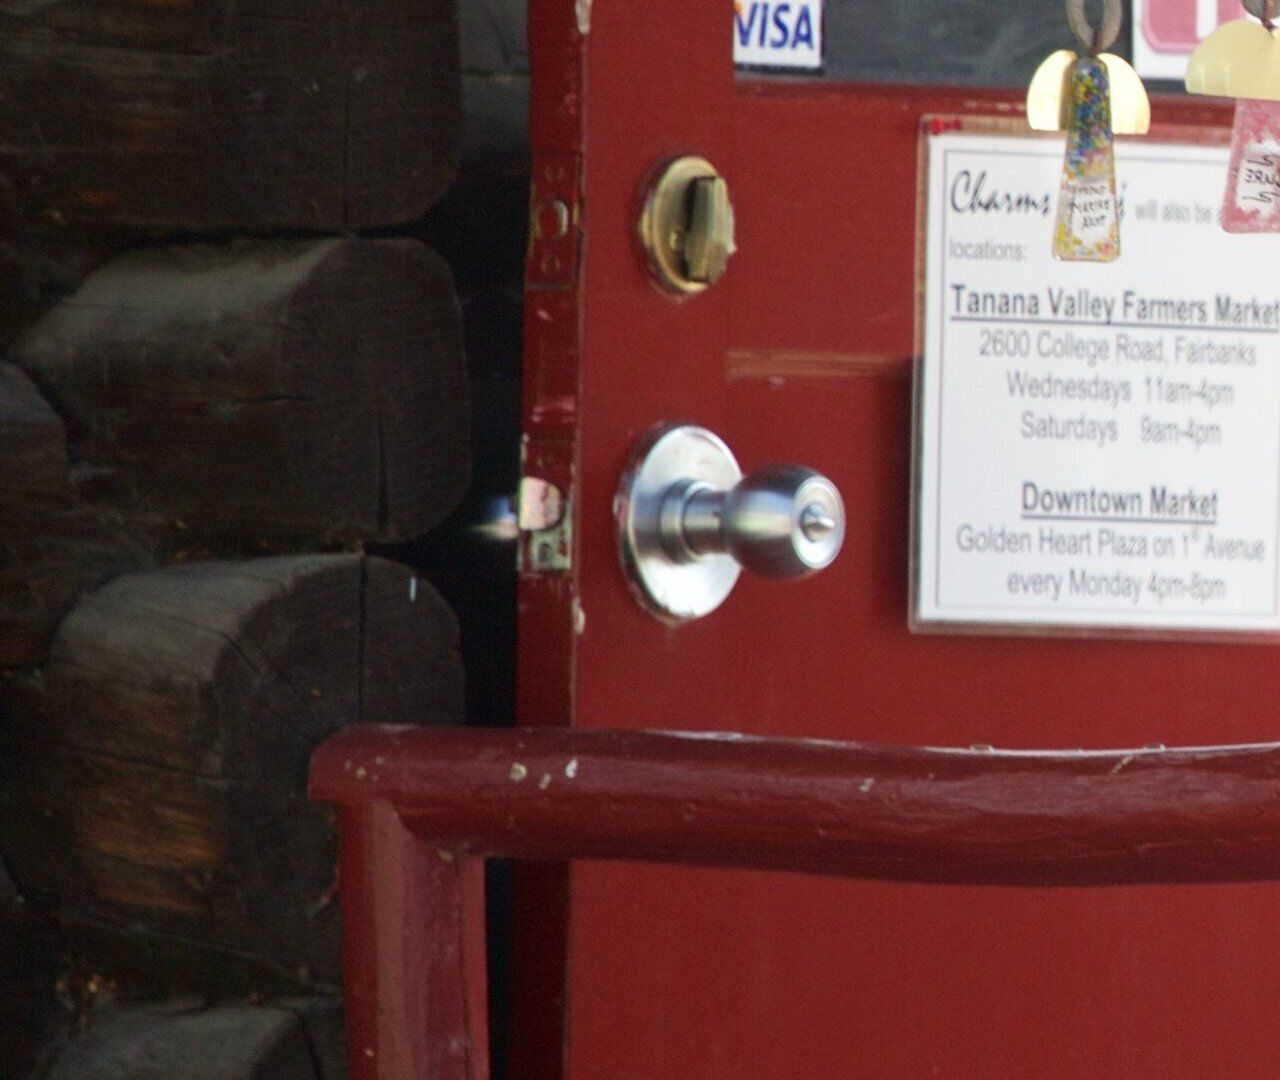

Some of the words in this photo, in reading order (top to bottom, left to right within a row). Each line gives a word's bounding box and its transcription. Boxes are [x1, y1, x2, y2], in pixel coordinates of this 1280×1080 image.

[736, 1, 814, 50] VISA
[950, 170, 1051, 216] Charms
[1135, 199, 1158, 220] will
[1162, 201, 1190, 222] also
[1194, 201, 1212, 223] be
[949, 238, 1027, 262] locations:
[951, 284, 1039, 314] Tanana
[1047, 287, 1115, 325] Valley
[1122, 290, 1207, 321] Farmers
[1215, 295, 1280, 326] Market
[979, 328, 1030, 358] 2600
[1036, 331, 1110, 366] College
[1115, 335, 1169, 364] Road,
[1175, 337, 1257, 367] Fairbanks
[1007, 371, 1131, 406] Wednesdays
[1144, 376, 1235, 410] 11am-4pm
[1020, 410, 1118, 447] Saturdays
[1141, 416, 1221, 449] 9am-4pm
[1022, 482, 1142, 513] Downtown
[1150, 486, 1218, 518] Market
[956, 524, 1031, 554] Golden
[1038, 527, 1092, 555] Heart
[1098, 529, 1147, 557] Plaza
[1153, 538, 1175, 558] on
[1205, 534, 1266, 562] Avenue
[1007, 572, 1063, 603] every
[1069, 569, 1143, 604] Monday
